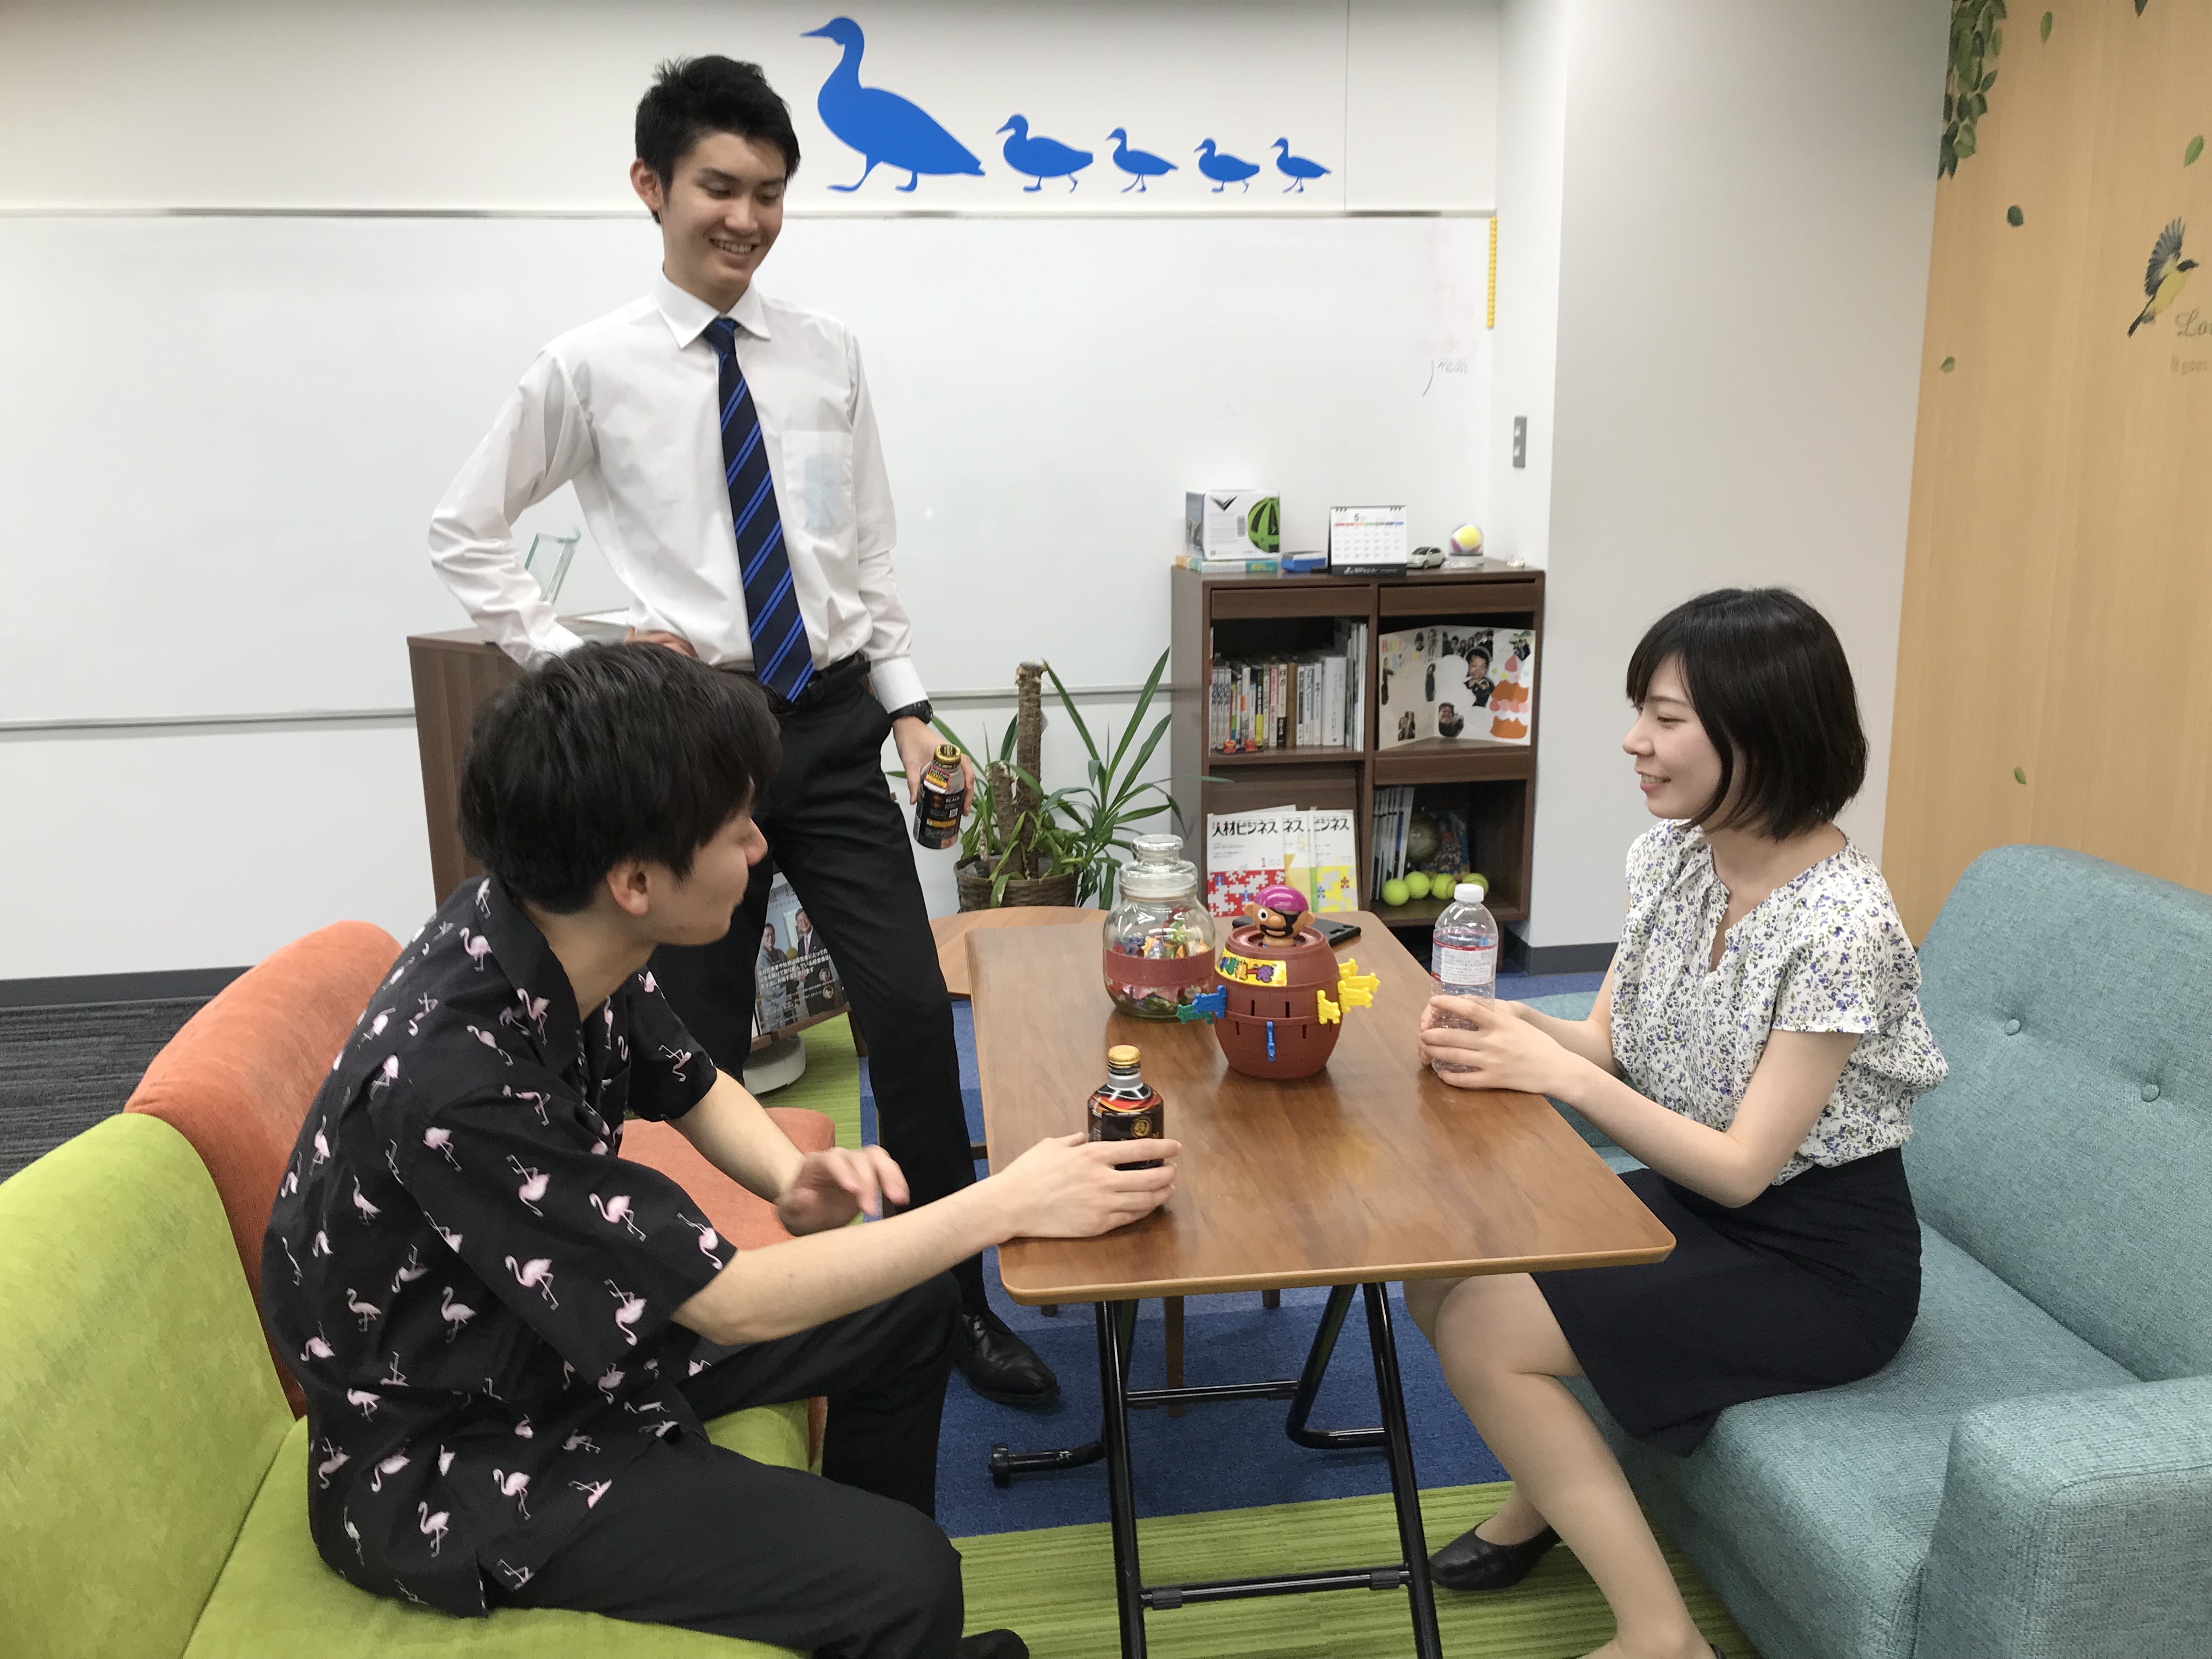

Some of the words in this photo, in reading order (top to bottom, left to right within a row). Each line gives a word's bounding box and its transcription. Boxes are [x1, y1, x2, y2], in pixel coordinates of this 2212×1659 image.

[2175, 307, 2212, 337] Lo
[1212, 820, 1279, 837] 人材ビジネス
[1283, 819, 1305, 833] ネス
[1297, 836, 1306, 850] 5
[1261, 857, 1266, 867] 1
